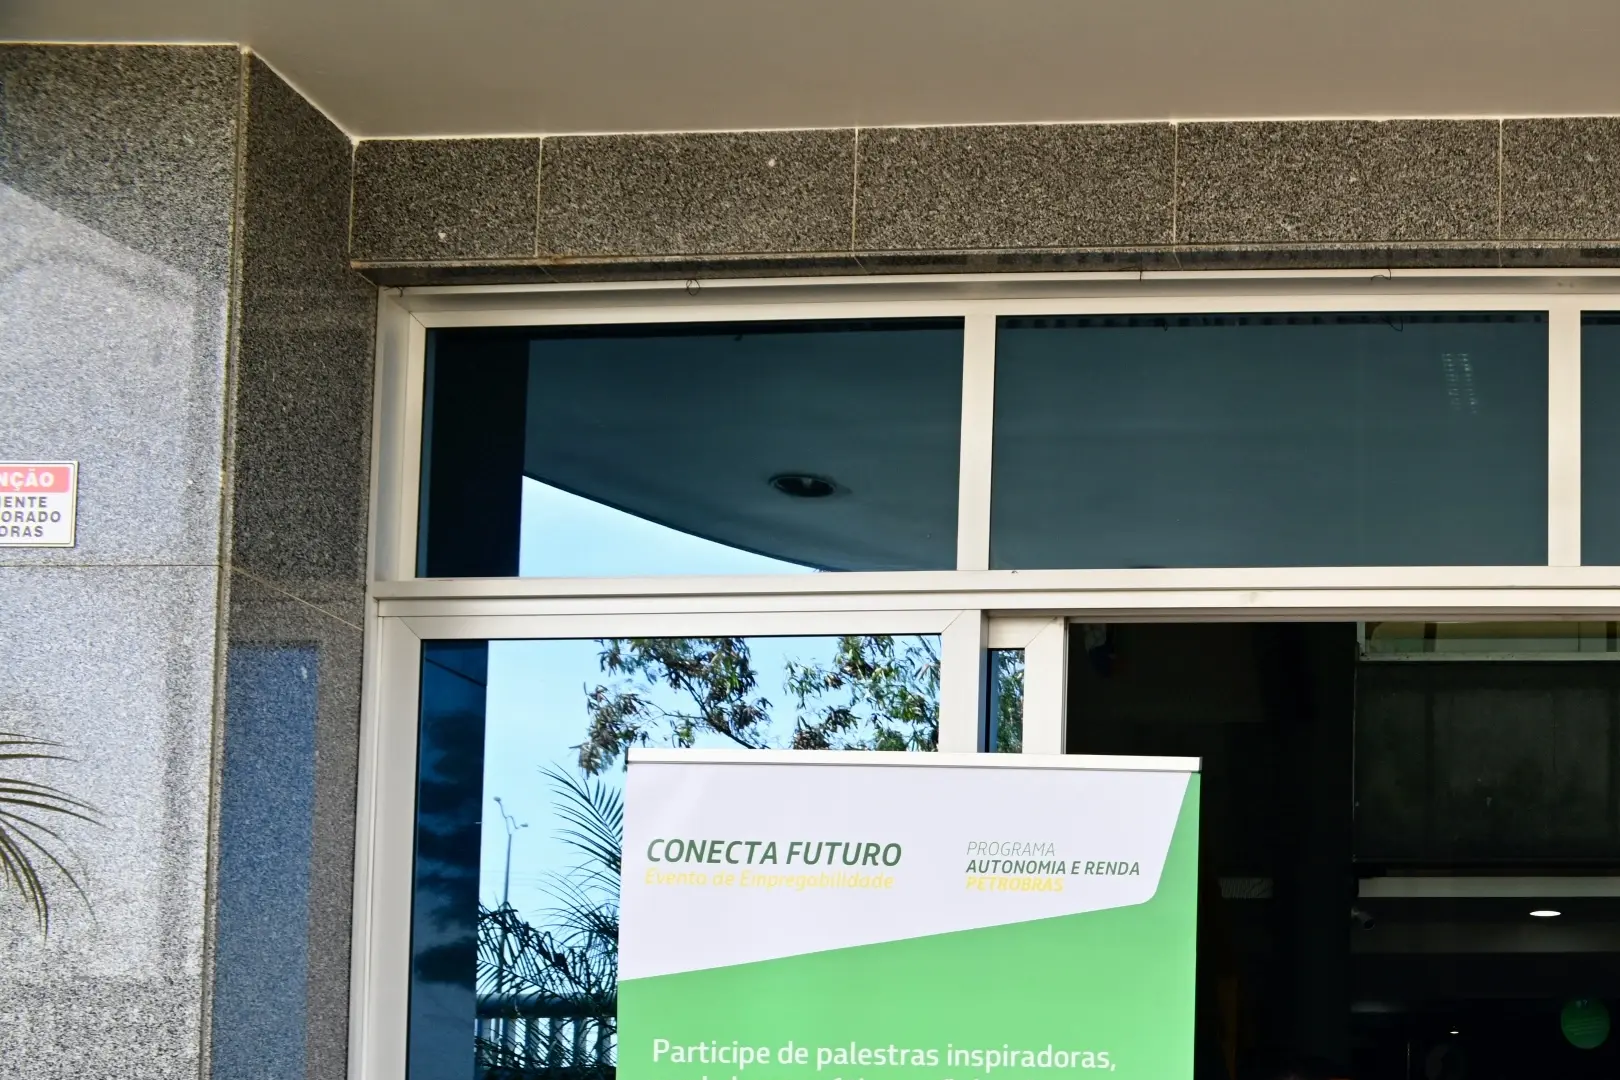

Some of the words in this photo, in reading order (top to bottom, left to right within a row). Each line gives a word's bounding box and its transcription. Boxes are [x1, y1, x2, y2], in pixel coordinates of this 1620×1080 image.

[0, 496, 48, 508] ENTE
[647, 838, 777, 865] CONECTA
[786, 841, 902, 867] FUTURO
[966, 841, 1056, 857] PROGRAMA
[966, 859, 1066, 875] AUTONOMIA
[1071, 860, 1081, 875] E
[1084, 861, 1140, 876] RENDA
[644, 867, 708, 886] Evento
[712, 870, 735, 887] de
[740, 869, 894, 892] Empregabilidade
[966, 876, 1064, 892] PETROBRAS
[652, 1037, 771, 1071] Participe
[777, 1039, 808, 1065] de
[816, 1040, 939, 1071] palestras
[947, 1043, 1116, 1075] inspiradoras,
